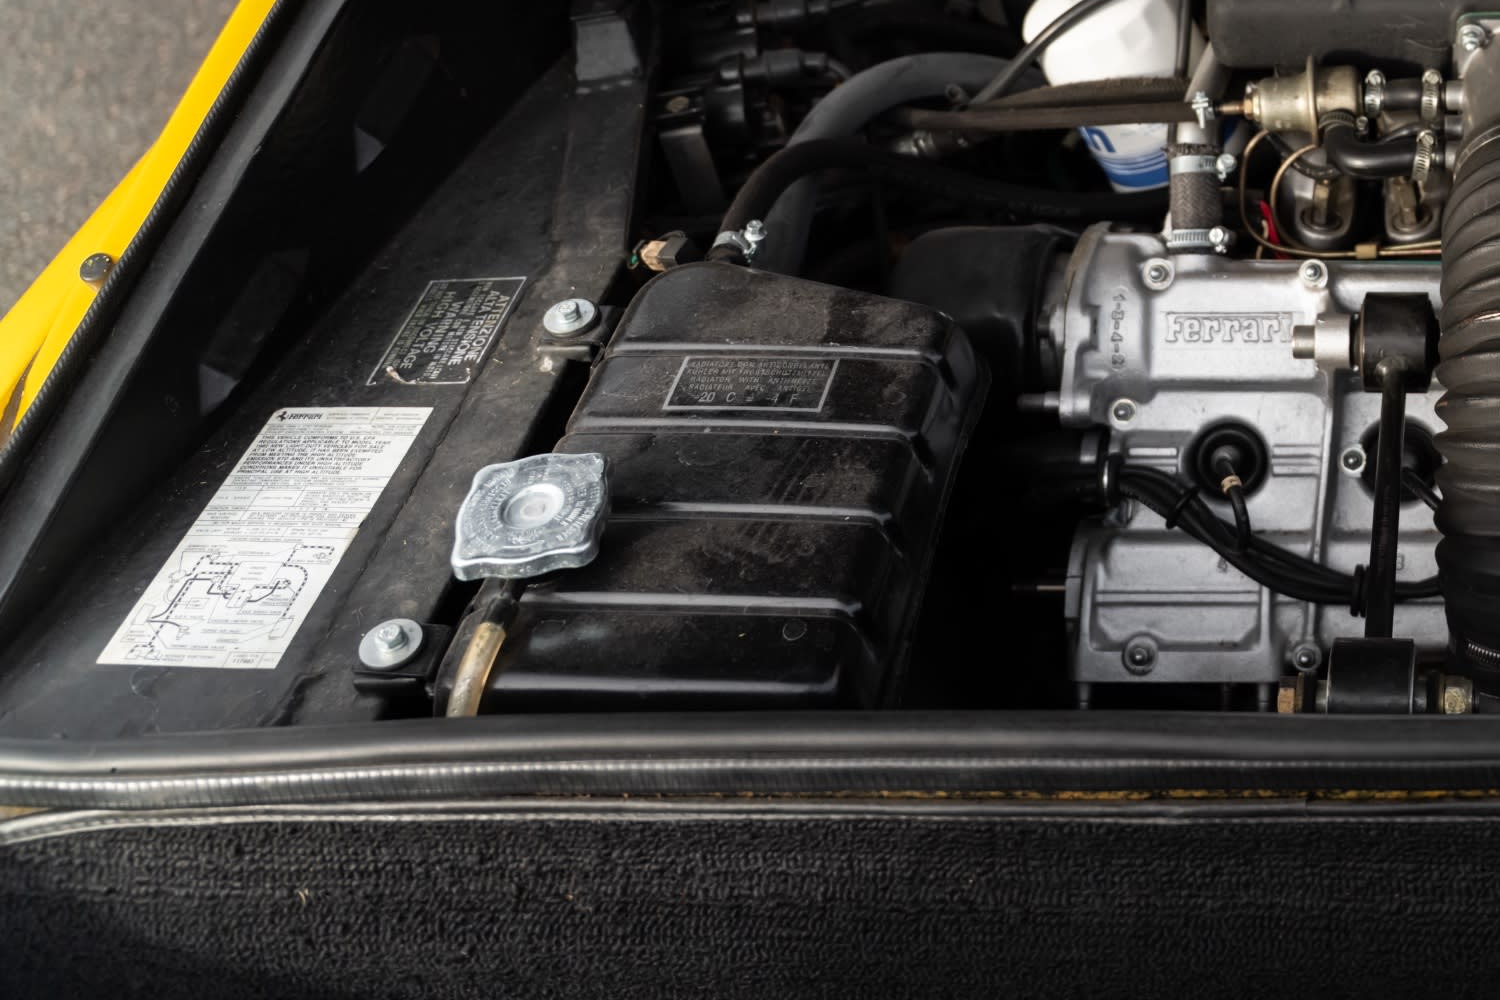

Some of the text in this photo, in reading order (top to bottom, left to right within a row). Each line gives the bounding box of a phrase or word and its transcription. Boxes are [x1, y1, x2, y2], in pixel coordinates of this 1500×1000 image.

[424, 301, 465, 353] WARNING
[431, 291, 457, 318] HIGH
[447, 290, 501, 366] ALTA TENSIONE
[464, 295, 510, 361] ATTENZIONE
[1164, 310, 1293, 343] Ferrari
[400, 322, 437, 369] VOLTAGE
